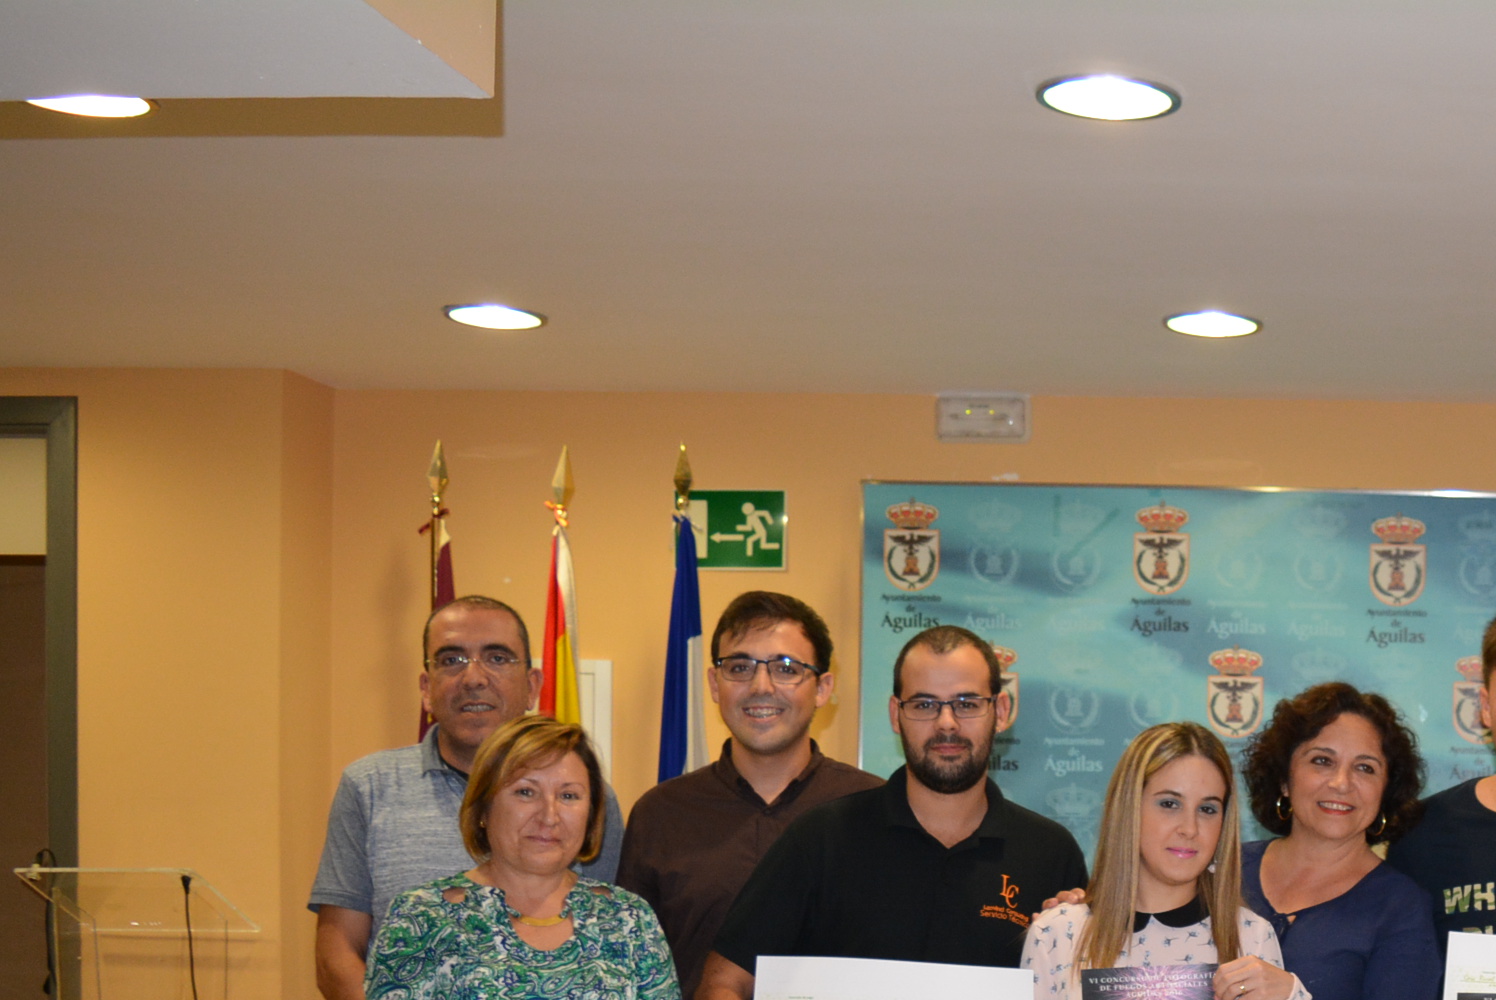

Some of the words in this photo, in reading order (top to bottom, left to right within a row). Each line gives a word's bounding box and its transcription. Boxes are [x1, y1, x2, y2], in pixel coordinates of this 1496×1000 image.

[881, 611, 940, 634] Águilas
[1130, 615, 1190, 637] Águilas
[1366, 626, 1426, 649] Águilas
[1043, 753, 1104, 777] Águilas
[1089, 977, 1099, 985] VI
[1099, 984, 1112, 992] DE
